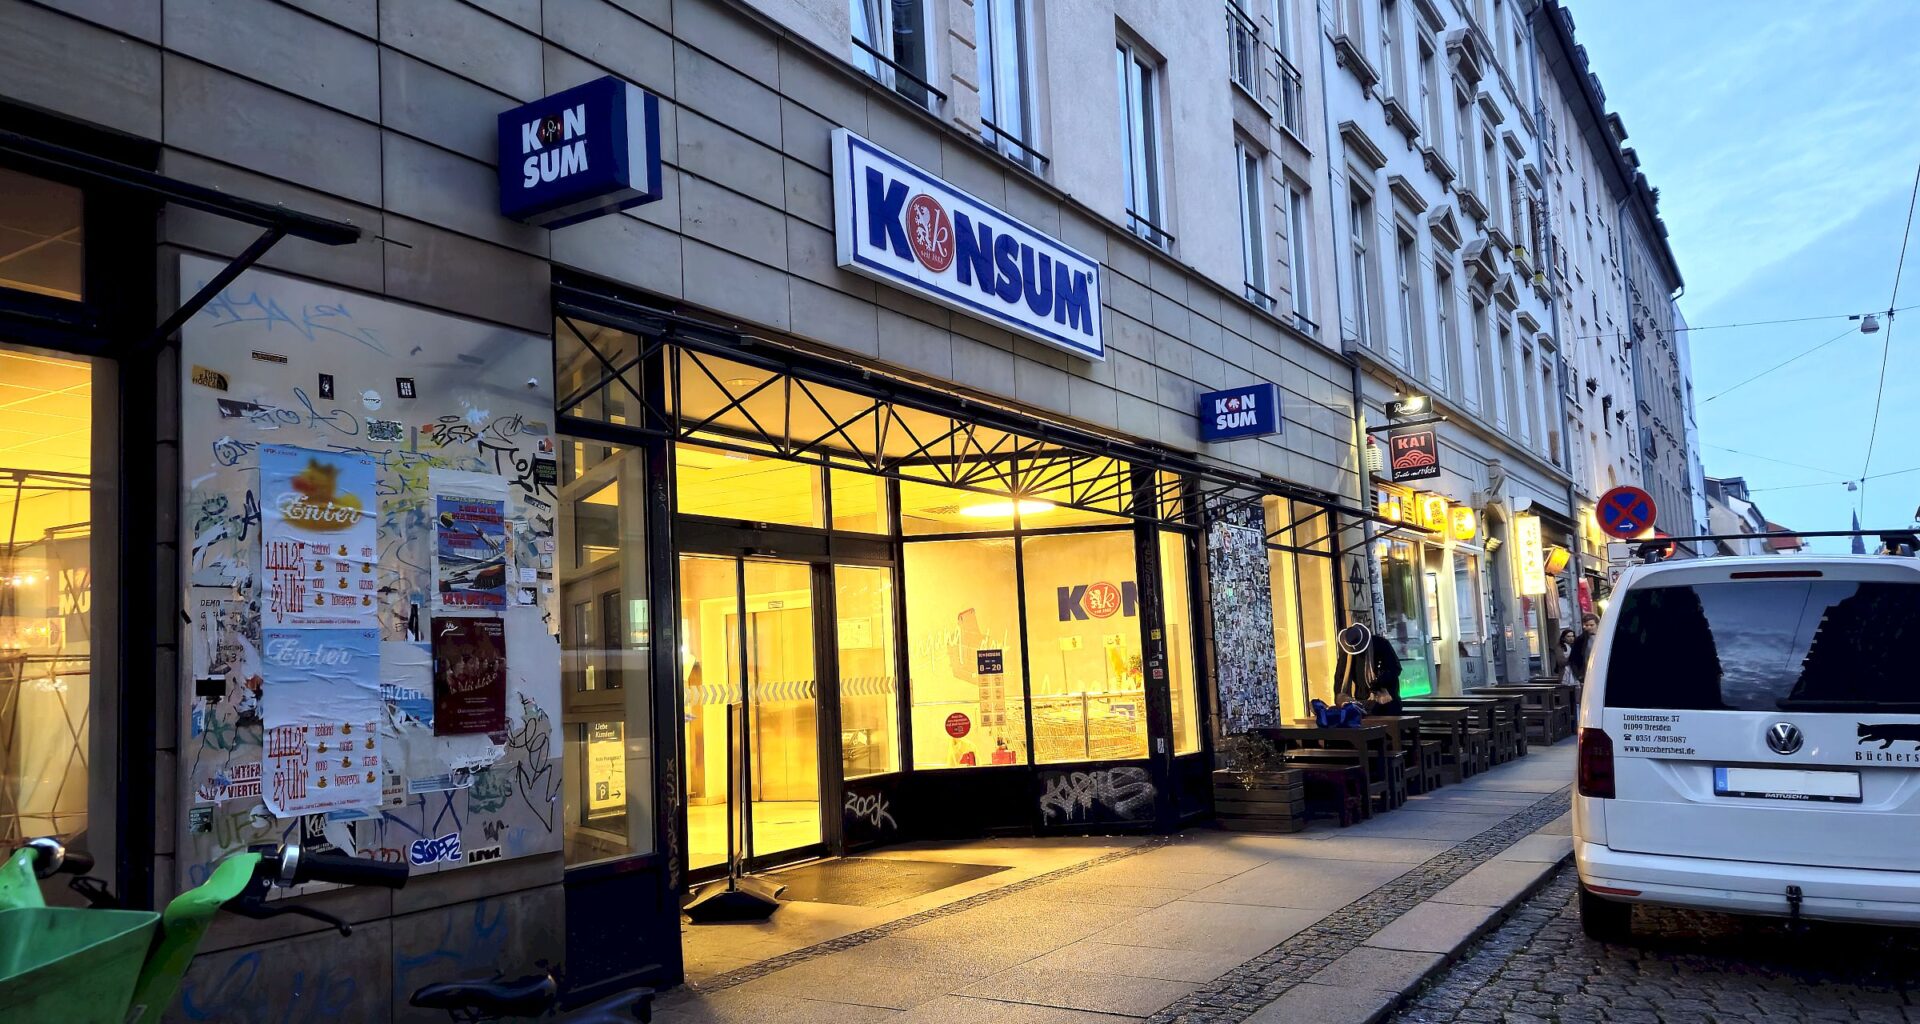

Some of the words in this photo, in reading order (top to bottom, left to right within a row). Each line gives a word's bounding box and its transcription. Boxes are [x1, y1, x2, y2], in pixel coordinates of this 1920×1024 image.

[523, 140, 589, 188] SUM
[1216, 410, 1257, 430] SUM
[1397, 435, 1426, 450] KAI
[284, 572, 306, 613] Uhr
[991, 663, 1002, 671] 20
[1635, 734, 1651, 742] 0351
[286, 759, 309, 800] Uhr
